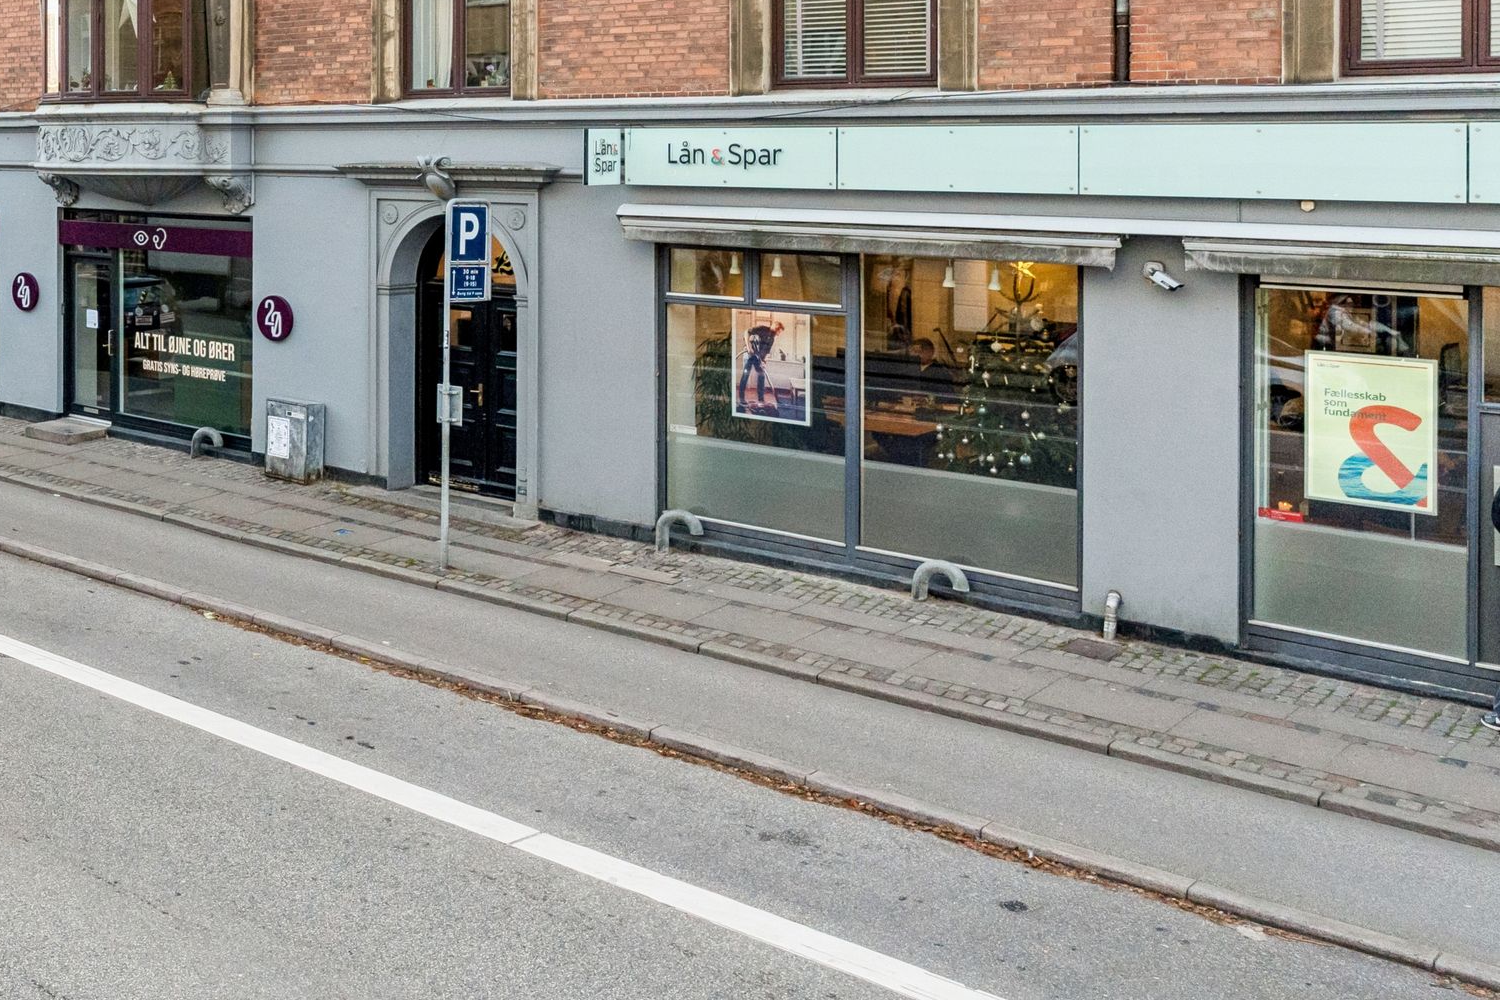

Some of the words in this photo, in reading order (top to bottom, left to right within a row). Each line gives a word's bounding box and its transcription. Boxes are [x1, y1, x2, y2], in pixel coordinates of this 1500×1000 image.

[595, 156, 617, 175] Spar
[668, 140, 705, 165] Lån
[711, 148, 725, 166] &
[728, 143, 782, 170] Spar
[459, 212, 480, 255] P
[134, 331, 150, 350] ALT
[152, 333, 167, 352] TIL
[168, 335, 192, 355] ØJNE
[193, 339, 206, 358] OG
[208, 340, 235, 362] ØRER
[142, 359, 163, 373] GRATIS
[182, 364, 191, 376] OG
[191, 365, 226, 382] HØREPRØVE
[1324, 387, 1387, 402] Fællesskab
[1324, 399, 1347, 408] som
[1324, 406, 1387, 420] fundament
